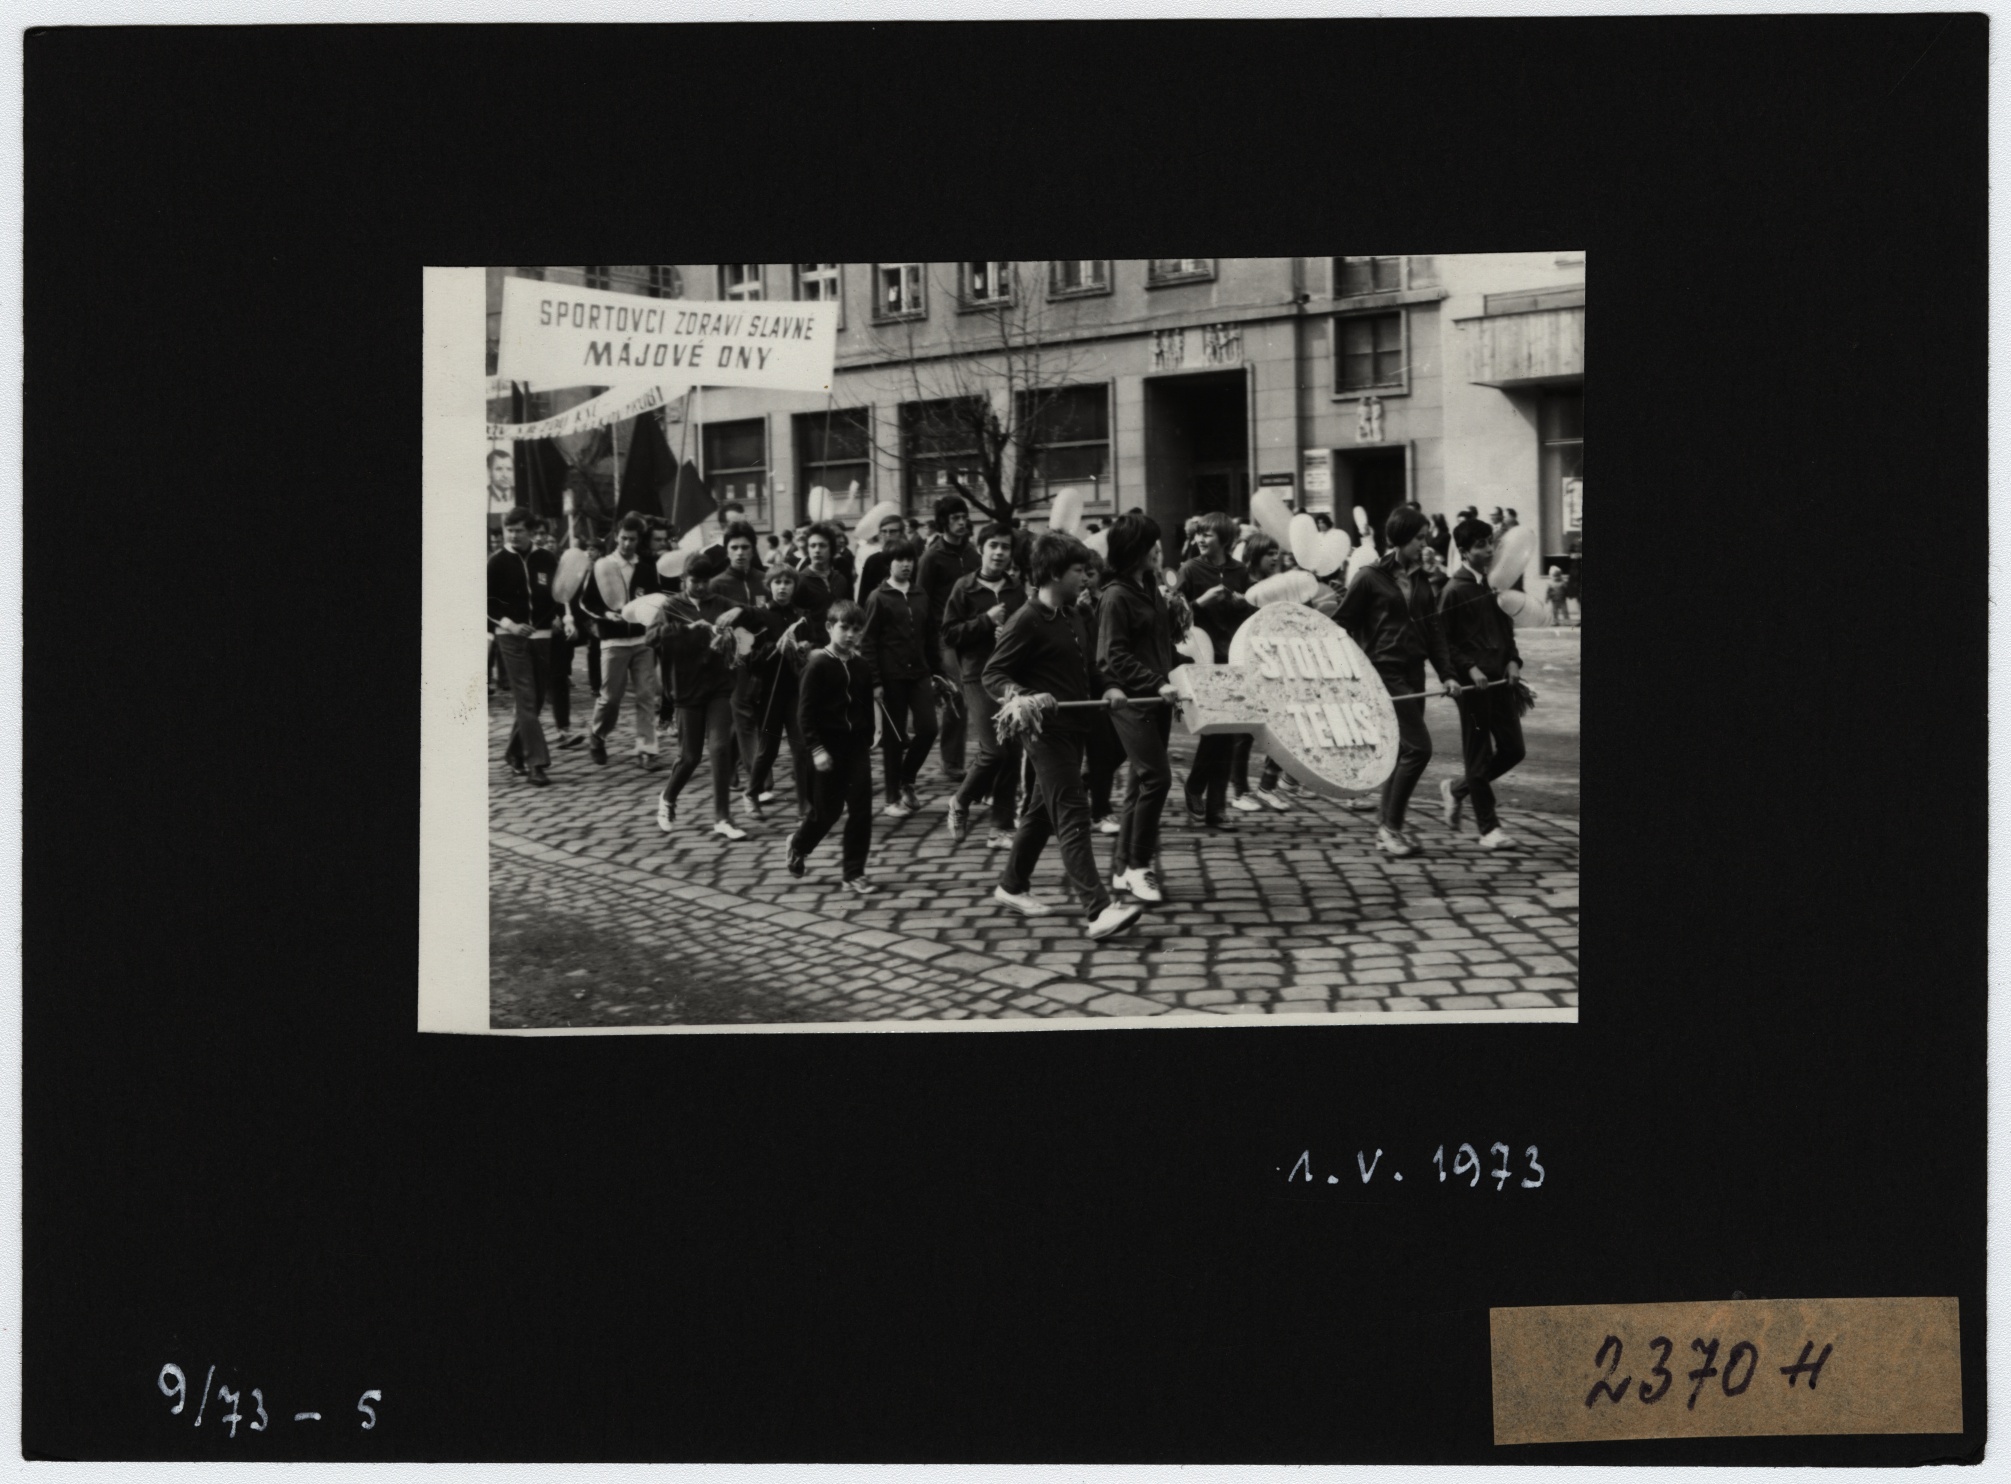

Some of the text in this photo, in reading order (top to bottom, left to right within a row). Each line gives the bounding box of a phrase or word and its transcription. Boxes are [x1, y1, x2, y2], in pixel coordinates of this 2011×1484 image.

[540, 299, 665, 334] SPORTOVCI
[583, 337, 704, 368] MÁJOVÉ
[1286, 702, 1381, 748] TENIS
[1287, 1141, 1546, 1191] 1. V. 1973
[1584, 1335, 1759, 1412] 2370
[157, 1362, 269, 1438] 9/73
[357, 1389, 382, 1430] 5
